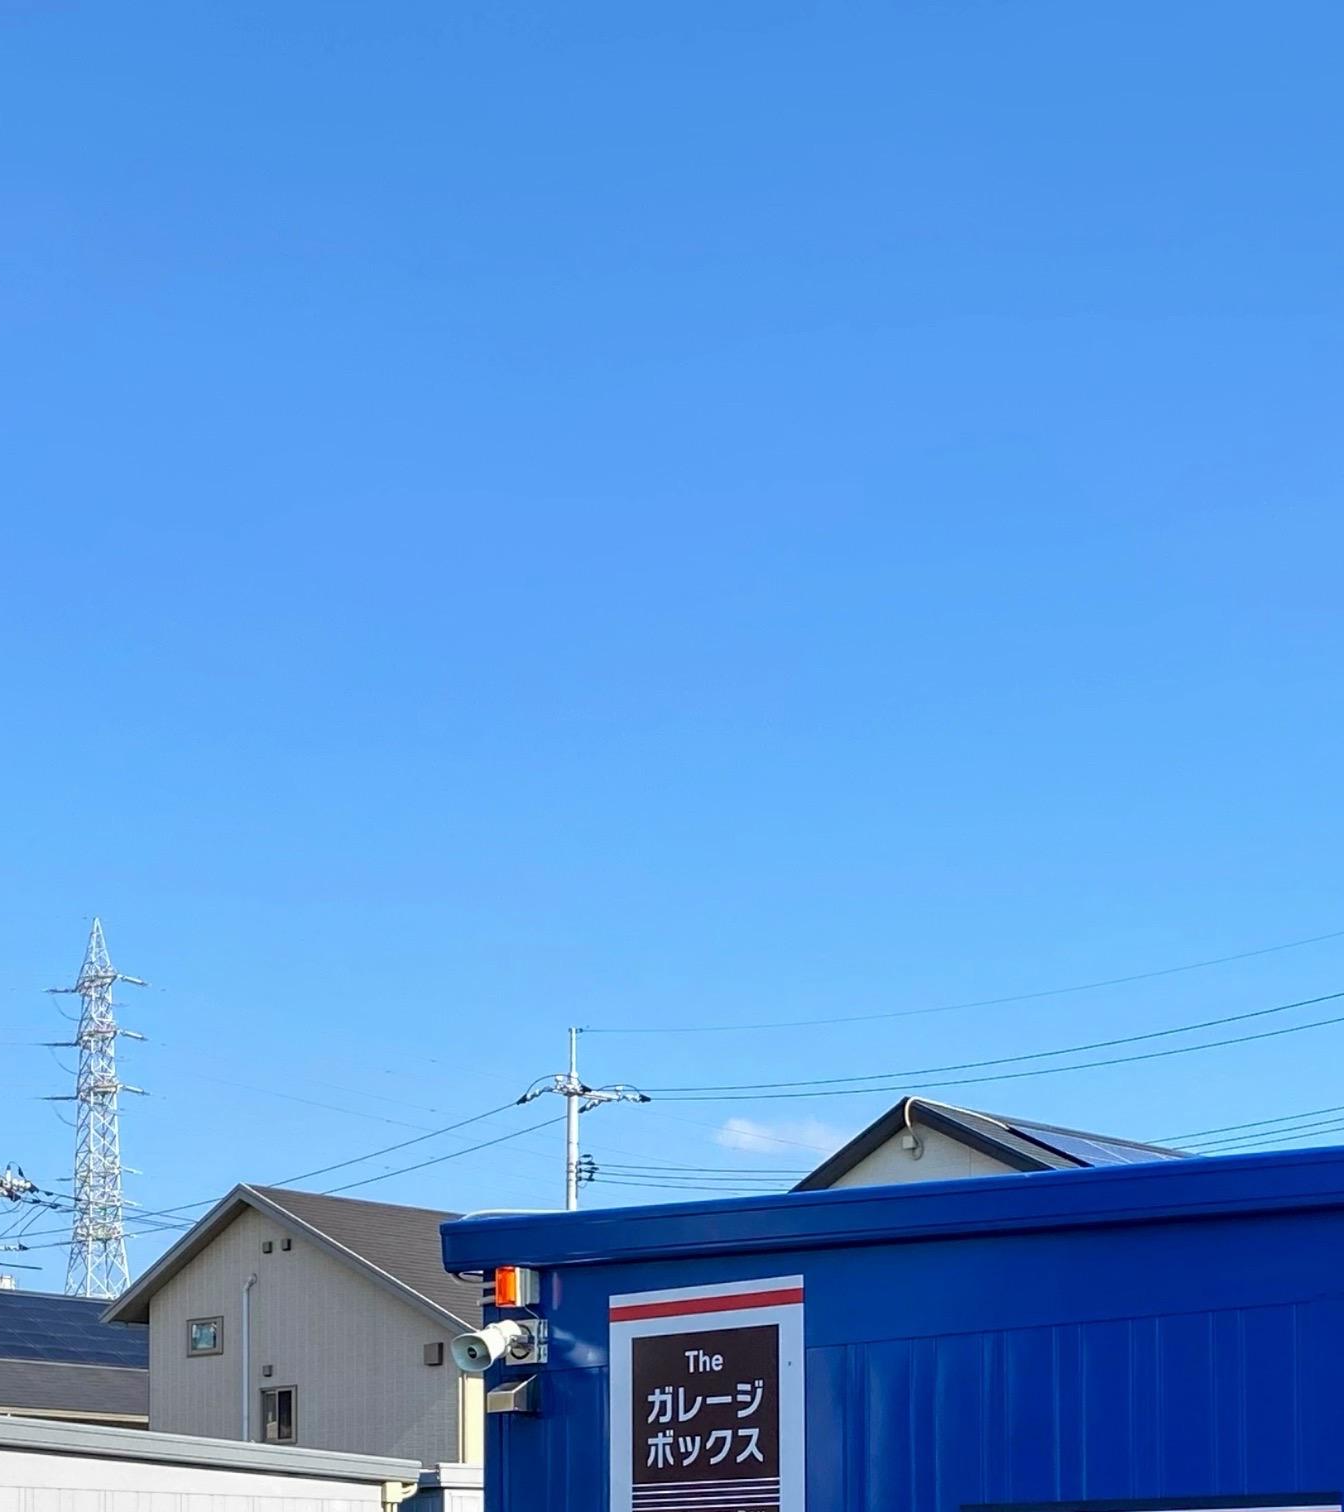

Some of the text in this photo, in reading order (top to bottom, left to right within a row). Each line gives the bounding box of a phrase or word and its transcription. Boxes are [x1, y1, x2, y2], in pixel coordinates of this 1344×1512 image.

[685, 1349, 724, 1373] The
[647, 1379, 763, 1424] ガレージ
[647, 1428, 764, 1468] ボックス
